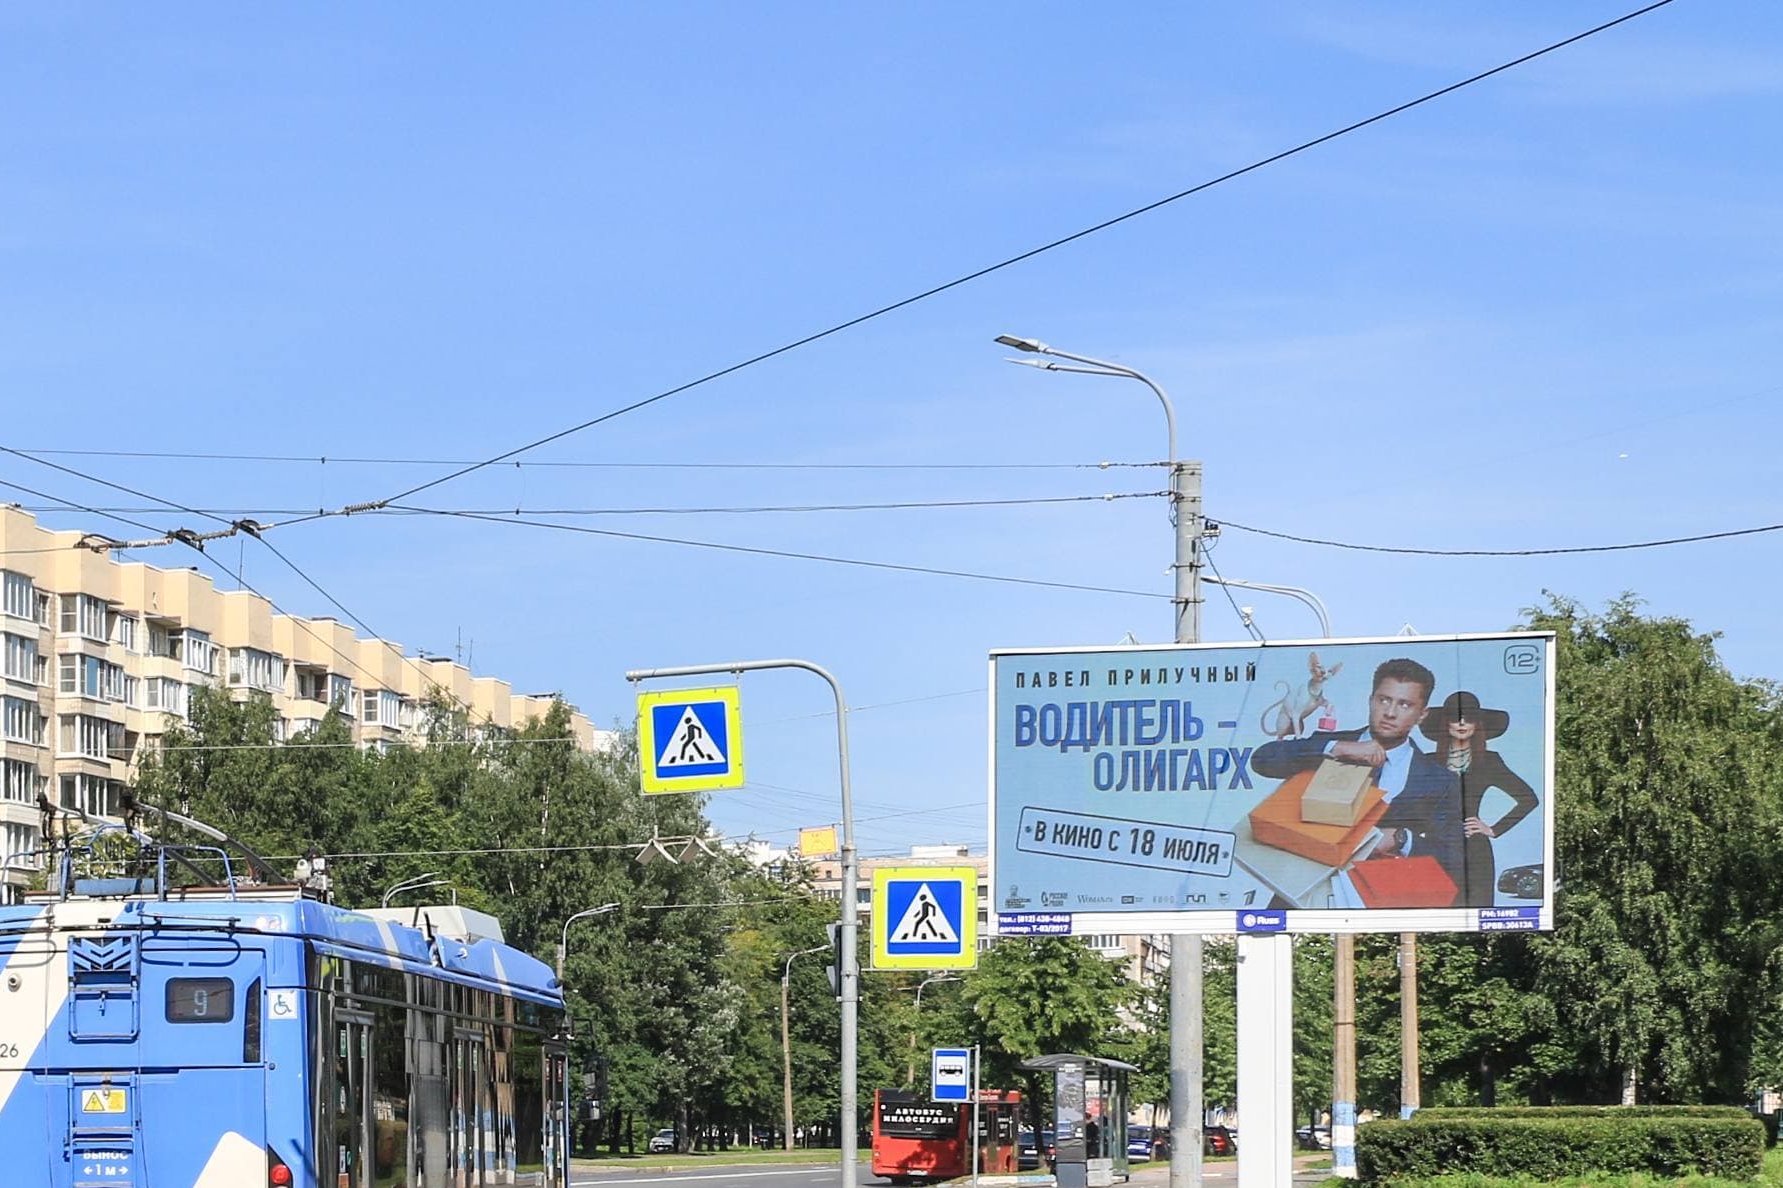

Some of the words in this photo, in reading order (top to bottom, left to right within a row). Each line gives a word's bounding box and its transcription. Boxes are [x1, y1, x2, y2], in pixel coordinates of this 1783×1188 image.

[1016, 670, 1090, 688] ПАВЕЛ
[1108, 662, 1257, 686] ПРИЛУЧНЫЙ
[1015, 699, 1204, 753] ВОДИТЕЛЬ
[1093, 747, 1254, 792] ОЛИГАРХ
[1034, 821, 1047, 842] В
[1052, 823, 1102, 850] КИНО
[1129, 828, 1155, 856] 18
[1163, 837, 1220, 865] ИЮЛЯ
[1257, 915, 1280, 925] Russ
[193, 989, 208, 1016] 9
[882, 1115, 954, 1124] МИЛОСЕРДИЯ
[895, 1107, 943, 1116] АВТОБУС
[95, 1163, 101, 1176] 1
